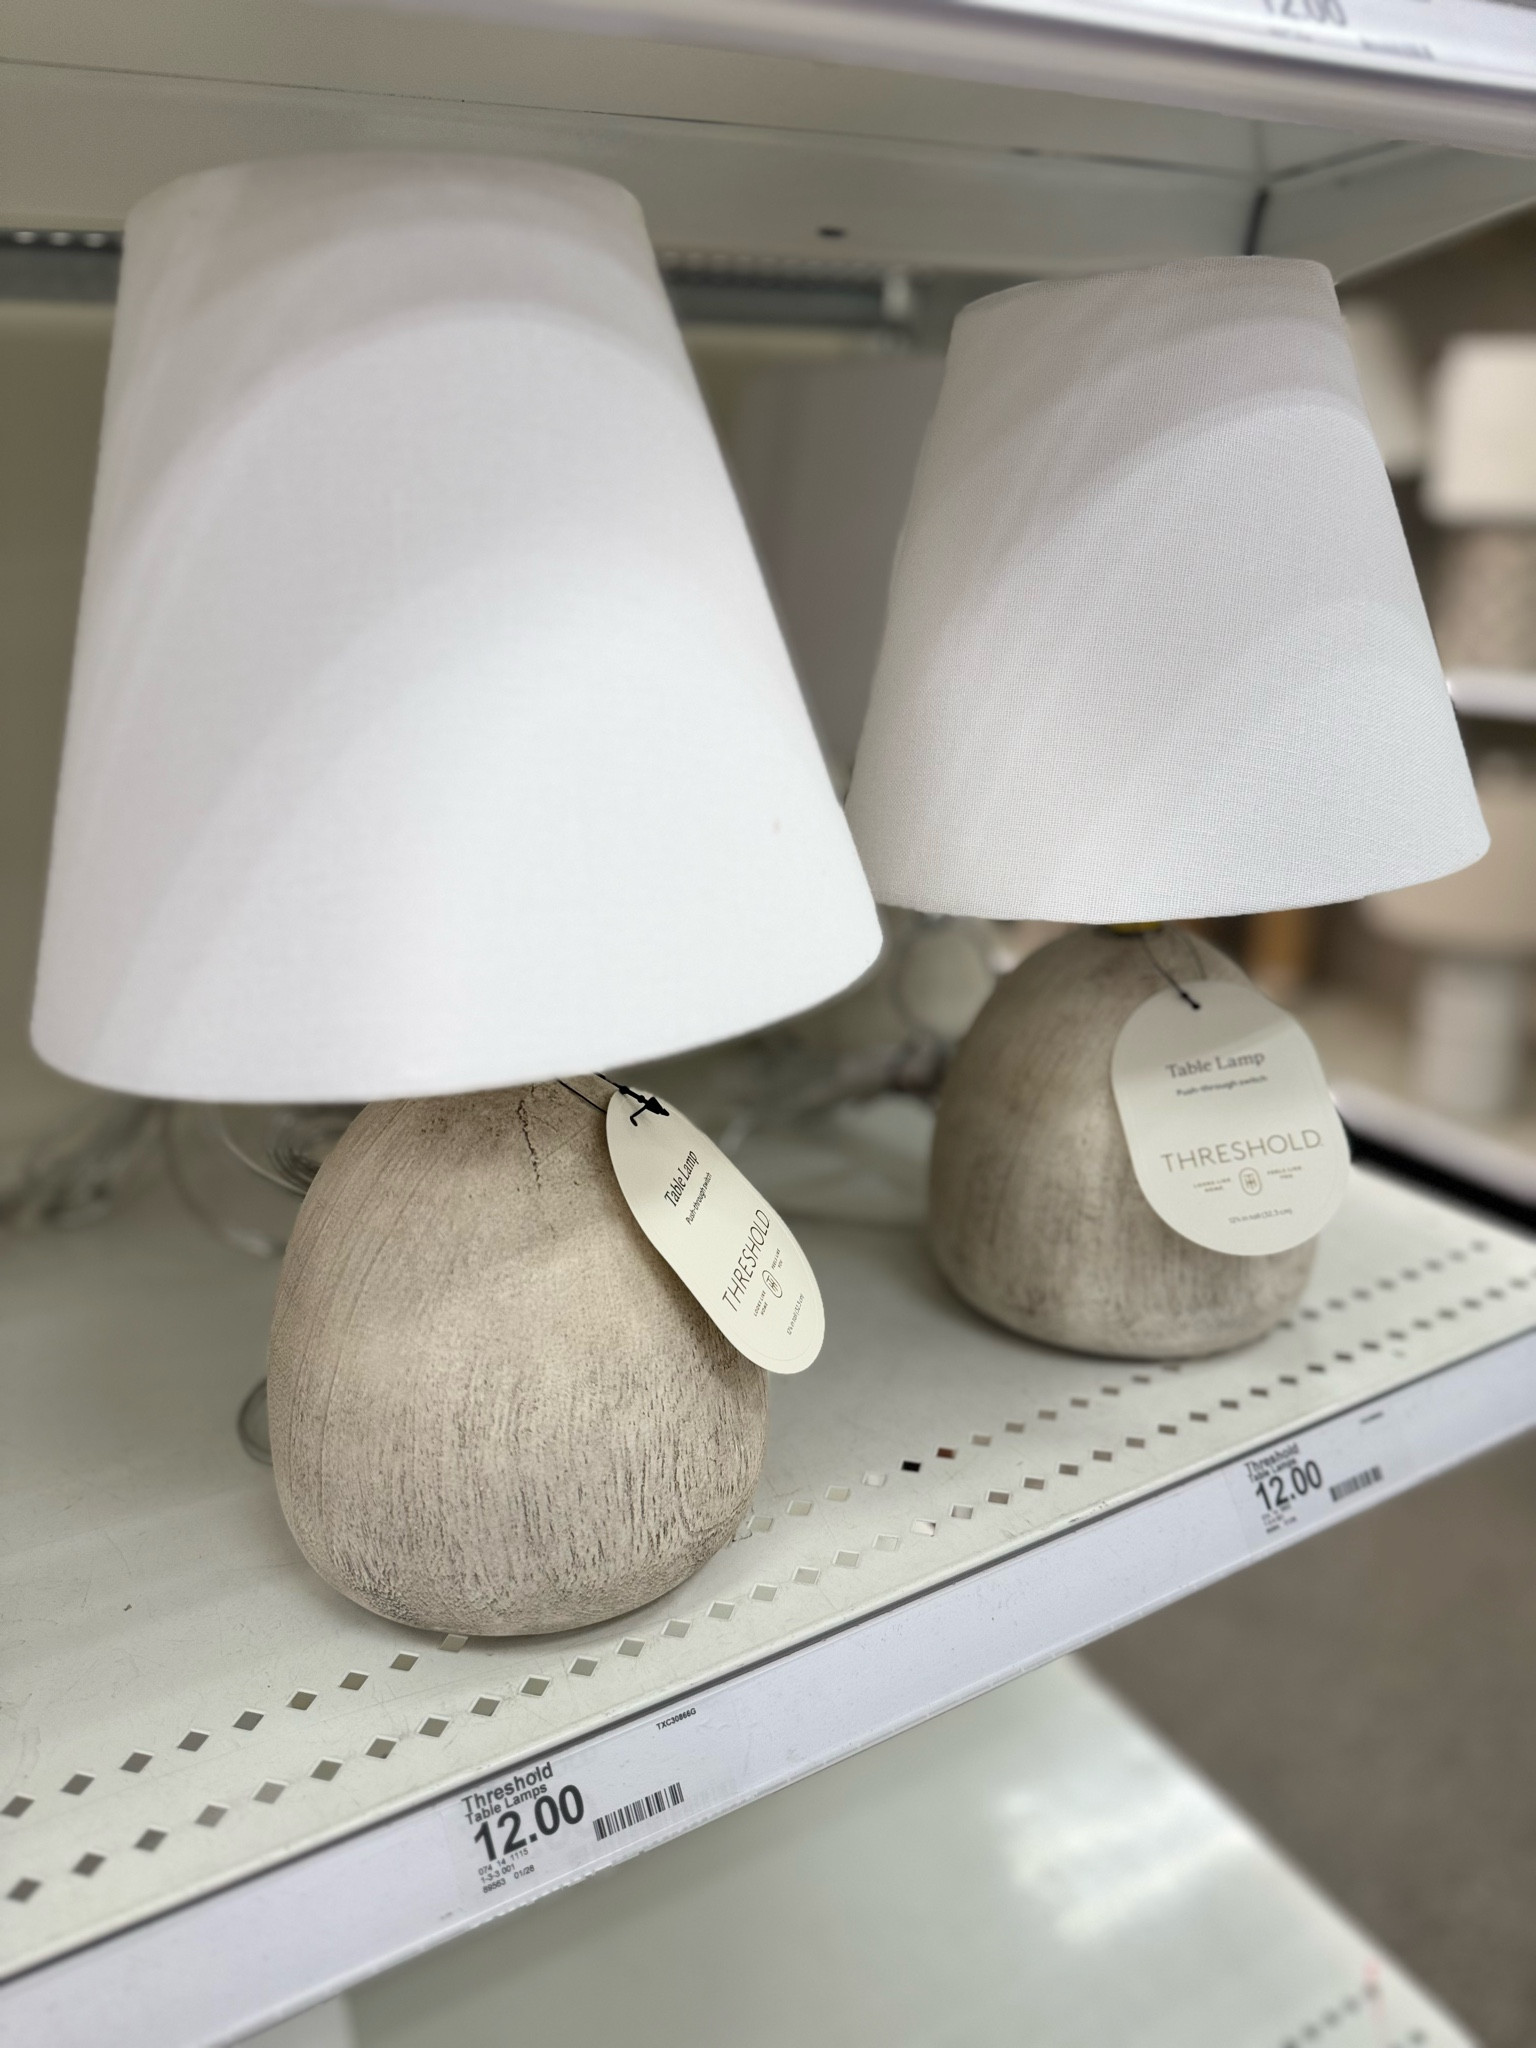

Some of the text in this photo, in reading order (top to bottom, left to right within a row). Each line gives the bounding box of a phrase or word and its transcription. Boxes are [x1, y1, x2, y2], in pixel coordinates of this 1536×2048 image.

[1165, 1053, 1265, 1079] Table Lamp
[1161, 1129, 1321, 1173] THRESHOLD
[664, 1150, 699, 1207] Table Lamp
[685, 1187, 706, 1225] Push-through
[722, 1209, 770, 1312] THRESHOLD
[1256, 1460, 1322, 1511] 12.00
[461, 1762, 553, 1813] Threshold
[465, 1783, 548, 1825] Table Lamps
[474, 1785, 584, 1861] 12.00
